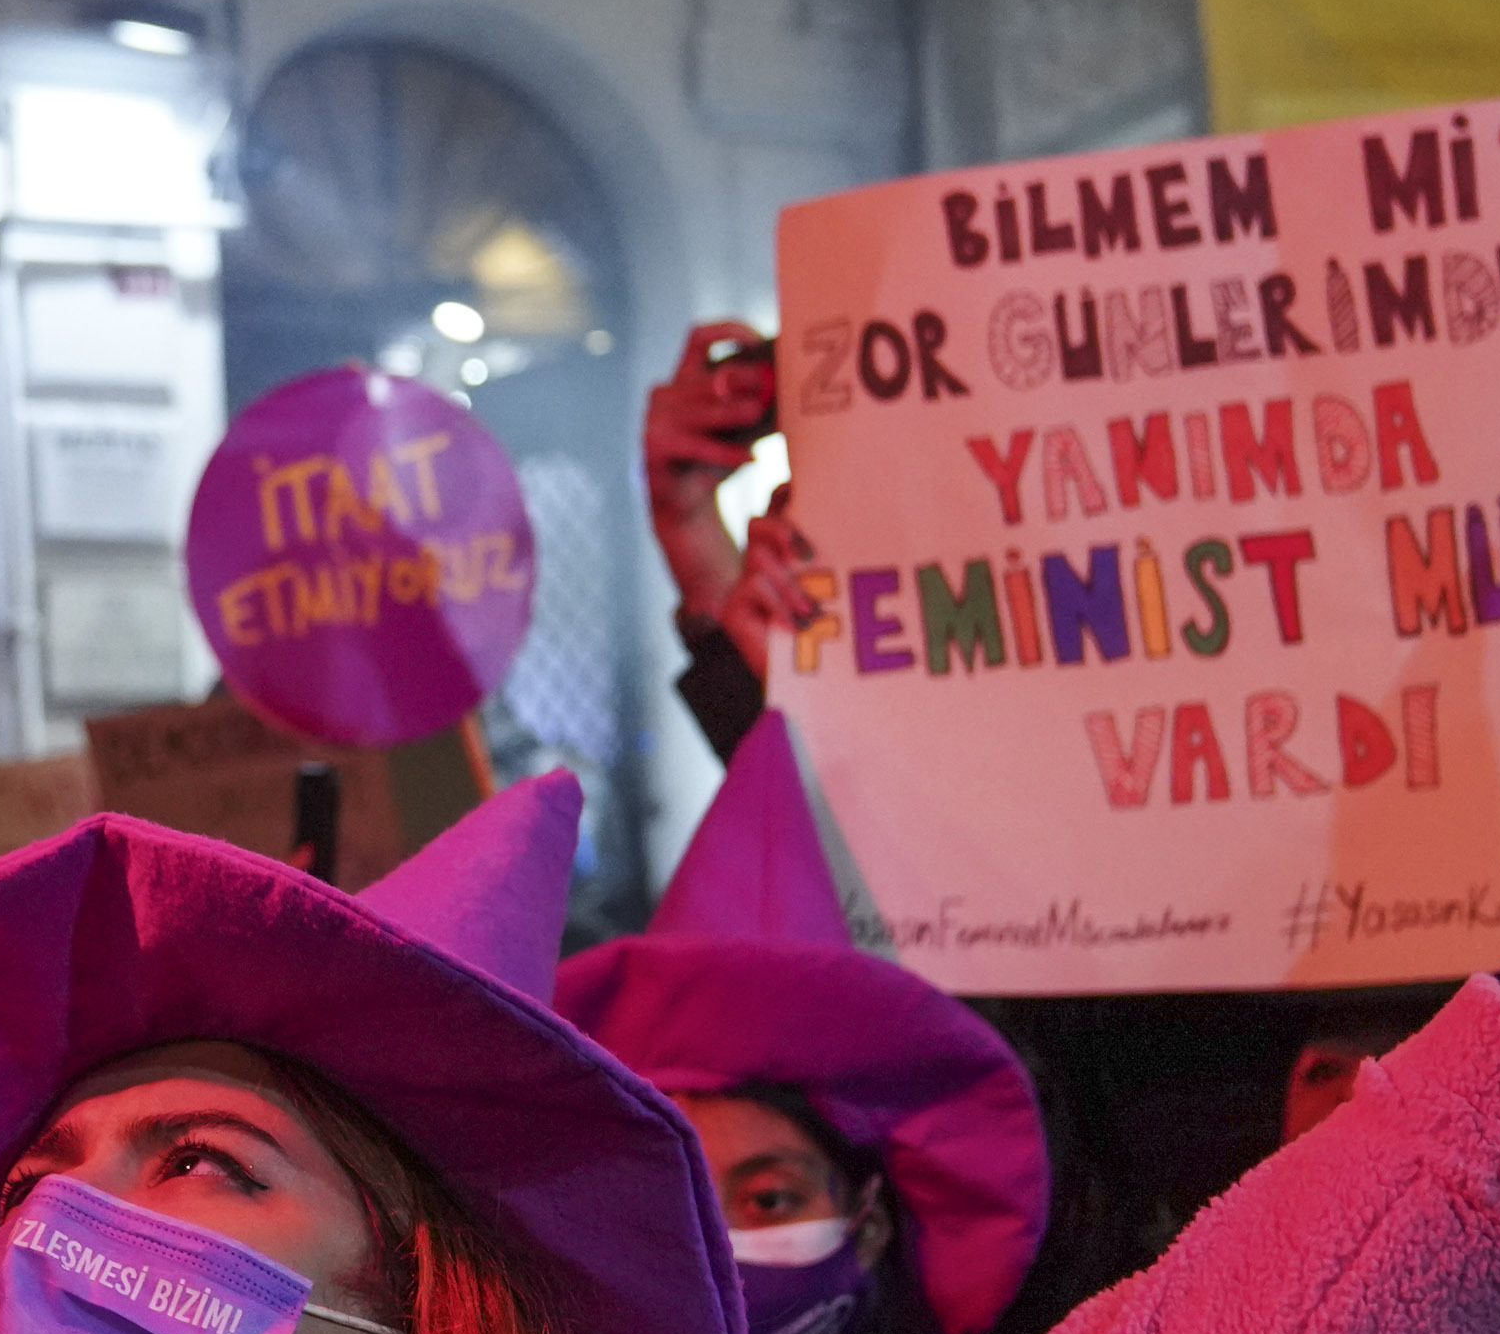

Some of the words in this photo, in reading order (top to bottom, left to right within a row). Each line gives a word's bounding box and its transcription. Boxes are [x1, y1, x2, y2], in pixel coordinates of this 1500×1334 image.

[940, 152, 1278, 268] BİLMEM
[800, 307, 970, 414] ZOR
[967, 381, 1441, 525] YANIMDA
[1085, 683, 1441, 810] VARDI
[10, 1217, 149, 1300] ZLEŞMESİ
